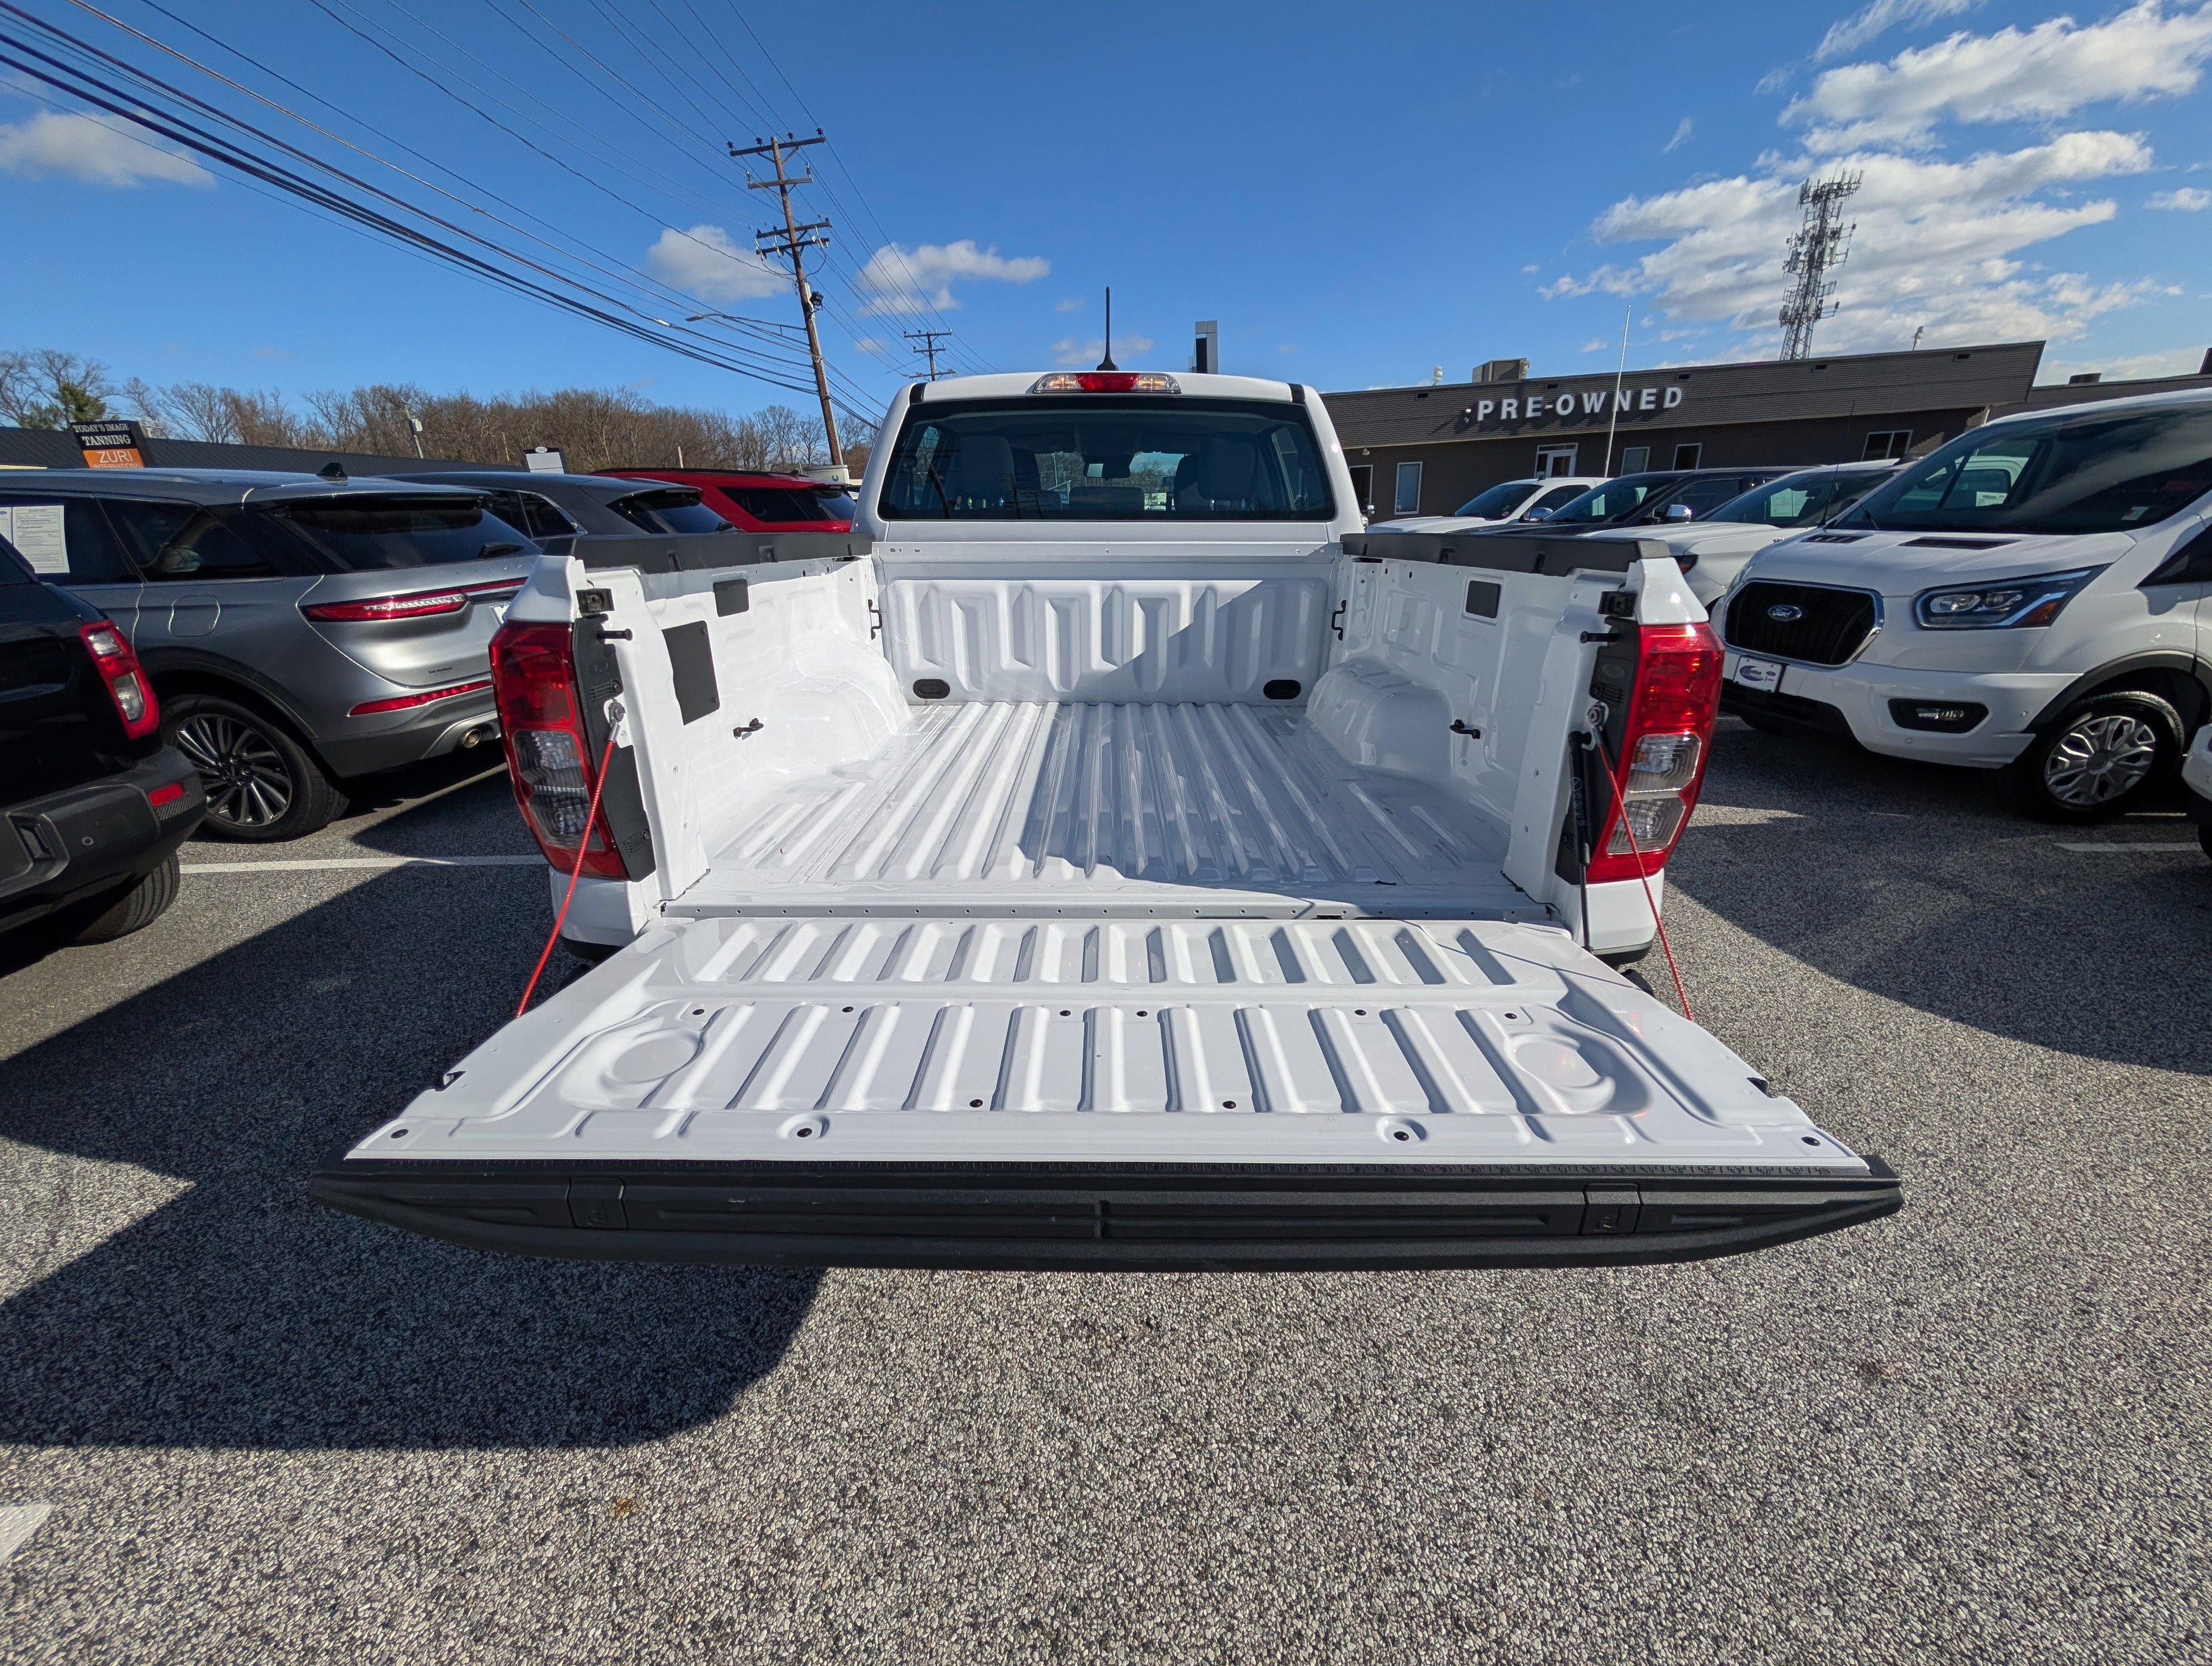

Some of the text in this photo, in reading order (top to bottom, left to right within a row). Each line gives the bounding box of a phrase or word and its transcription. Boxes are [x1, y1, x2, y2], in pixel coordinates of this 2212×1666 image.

[1477, 387, 1683, 422] PRE-OWNED
[73, 423, 130, 433] TODAY'S IMAGE
[82, 434, 131, 446] TANNING
[97, 450, 133, 463] ZURI
